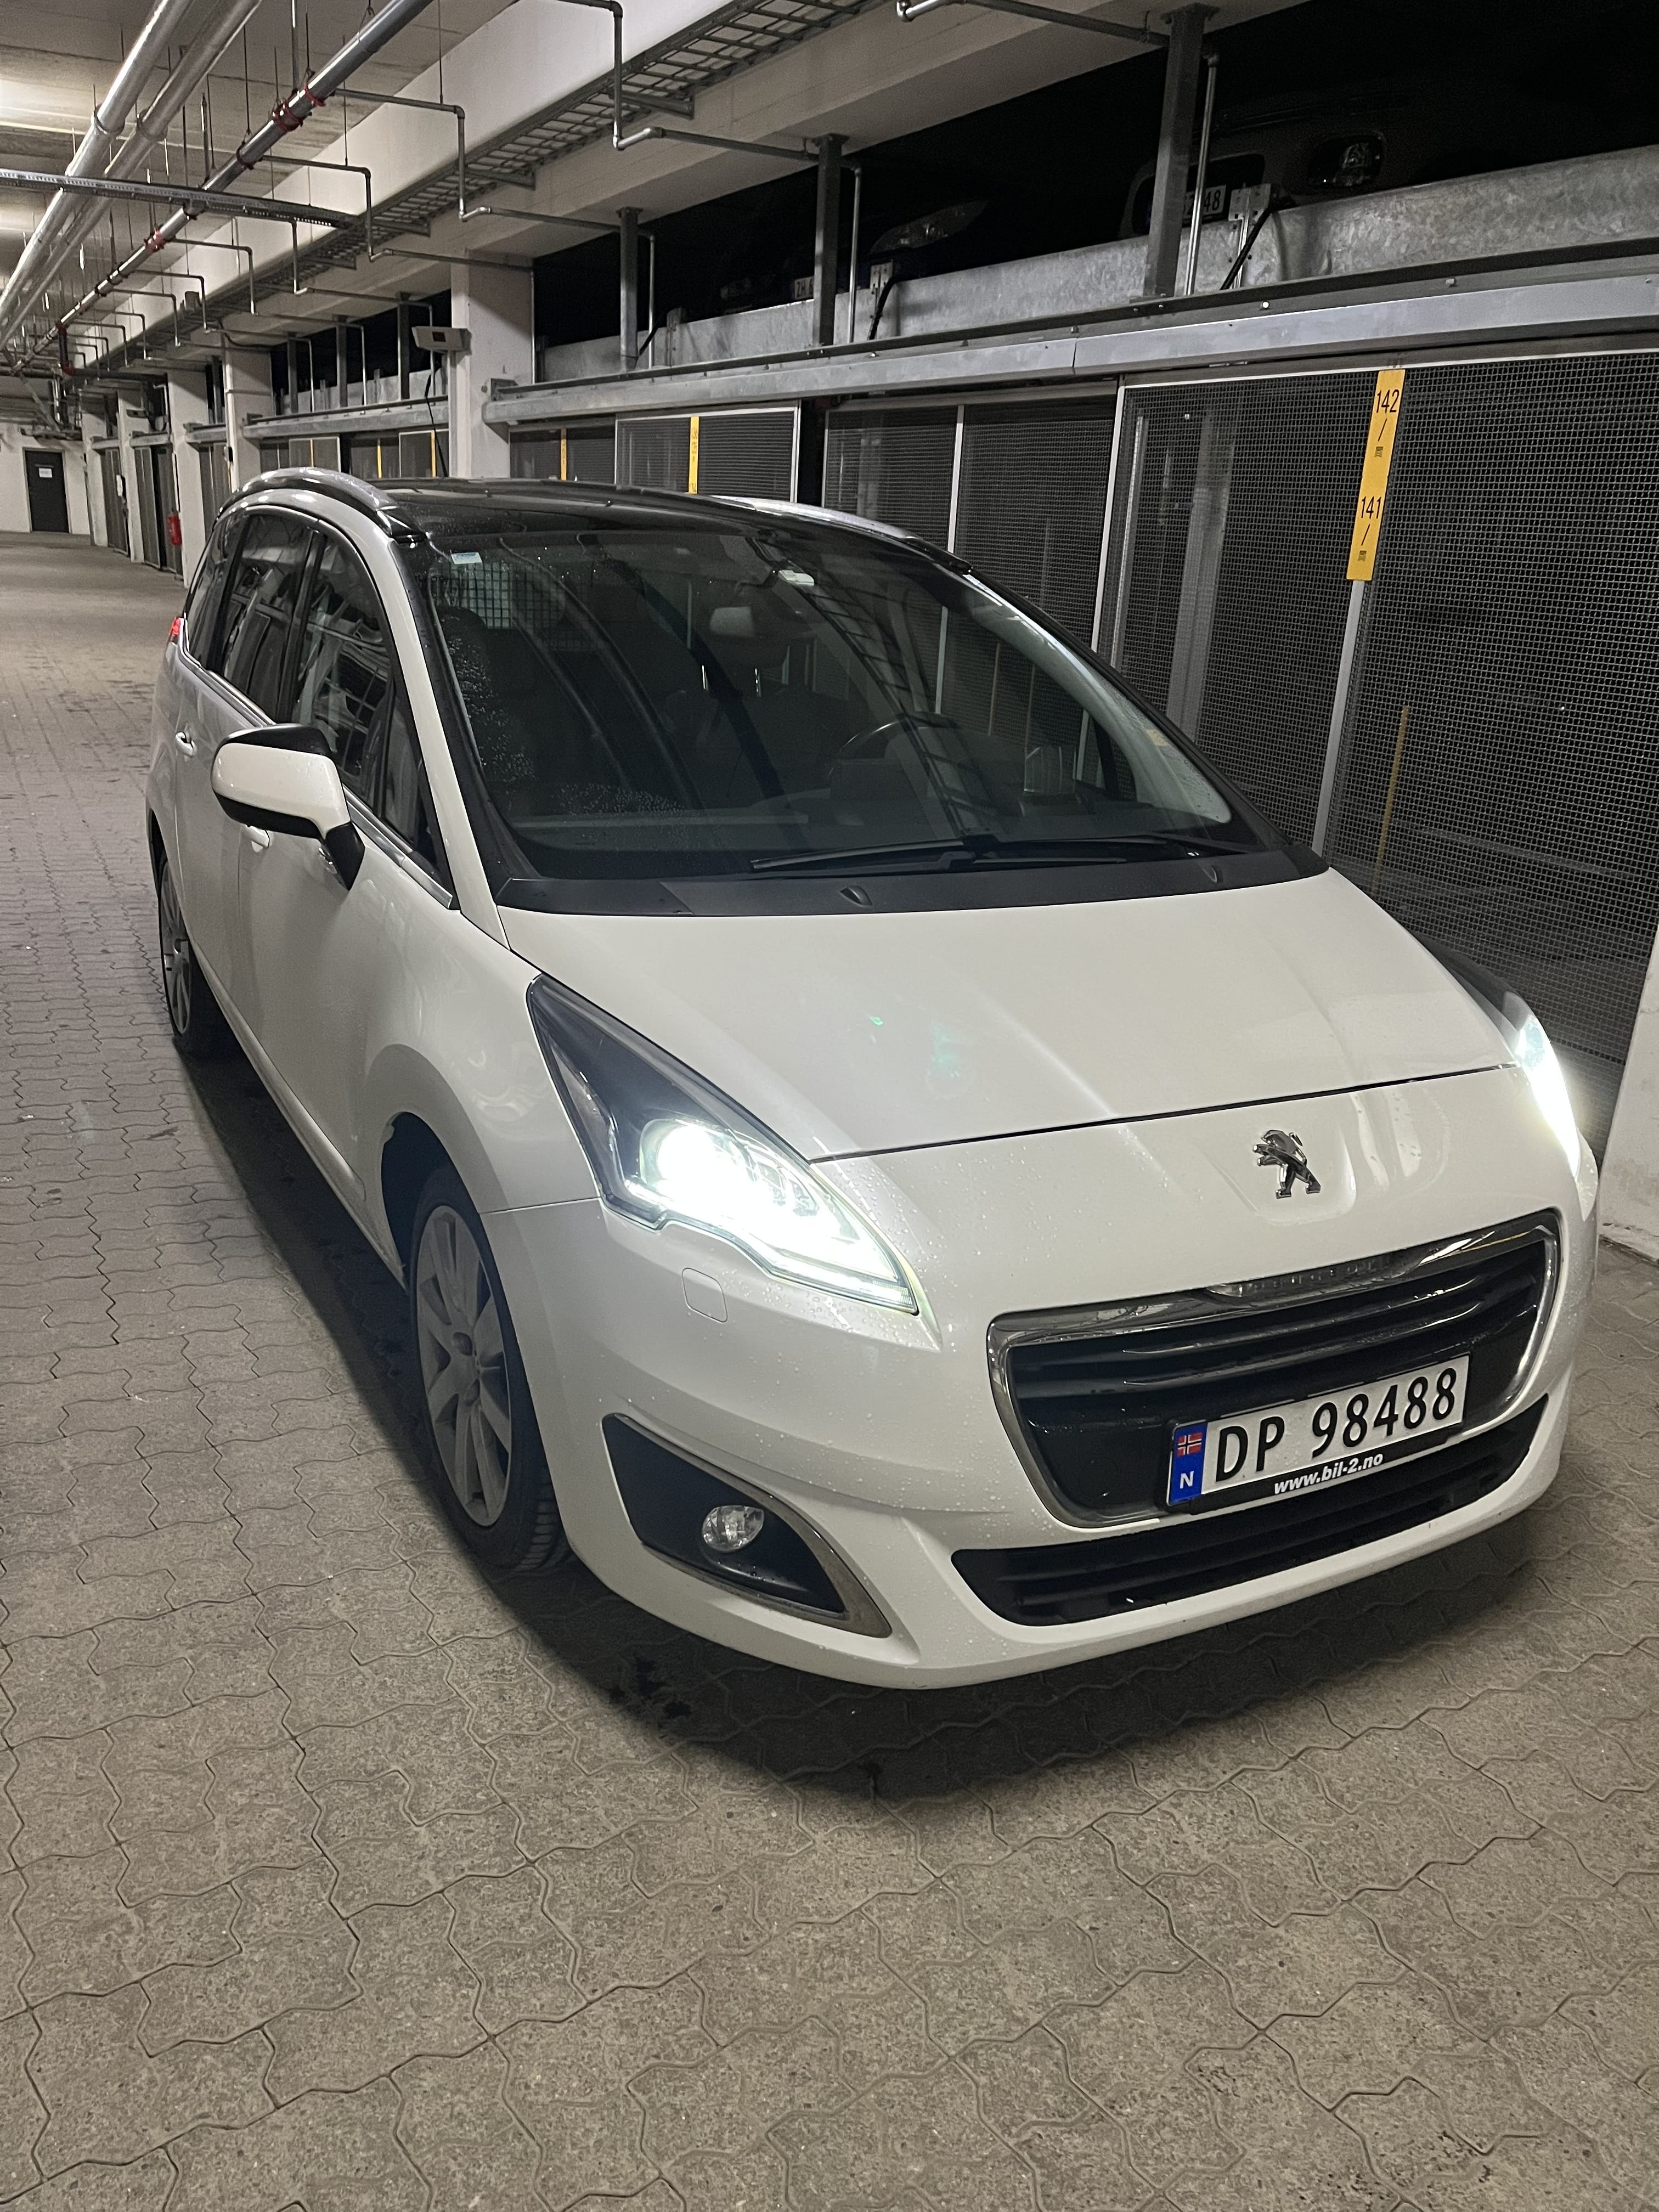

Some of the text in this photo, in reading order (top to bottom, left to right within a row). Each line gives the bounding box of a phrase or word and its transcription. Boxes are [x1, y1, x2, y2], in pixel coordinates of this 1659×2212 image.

[1376, 389, 1400, 413] 142
[1361, 496, 1381, 519] 141
[1216, 1368, 1457, 1482] DP 98488
[1180, 1471, 1193, 1489] N
[1274, 1453, 1383, 1494] www.bil-2.no
